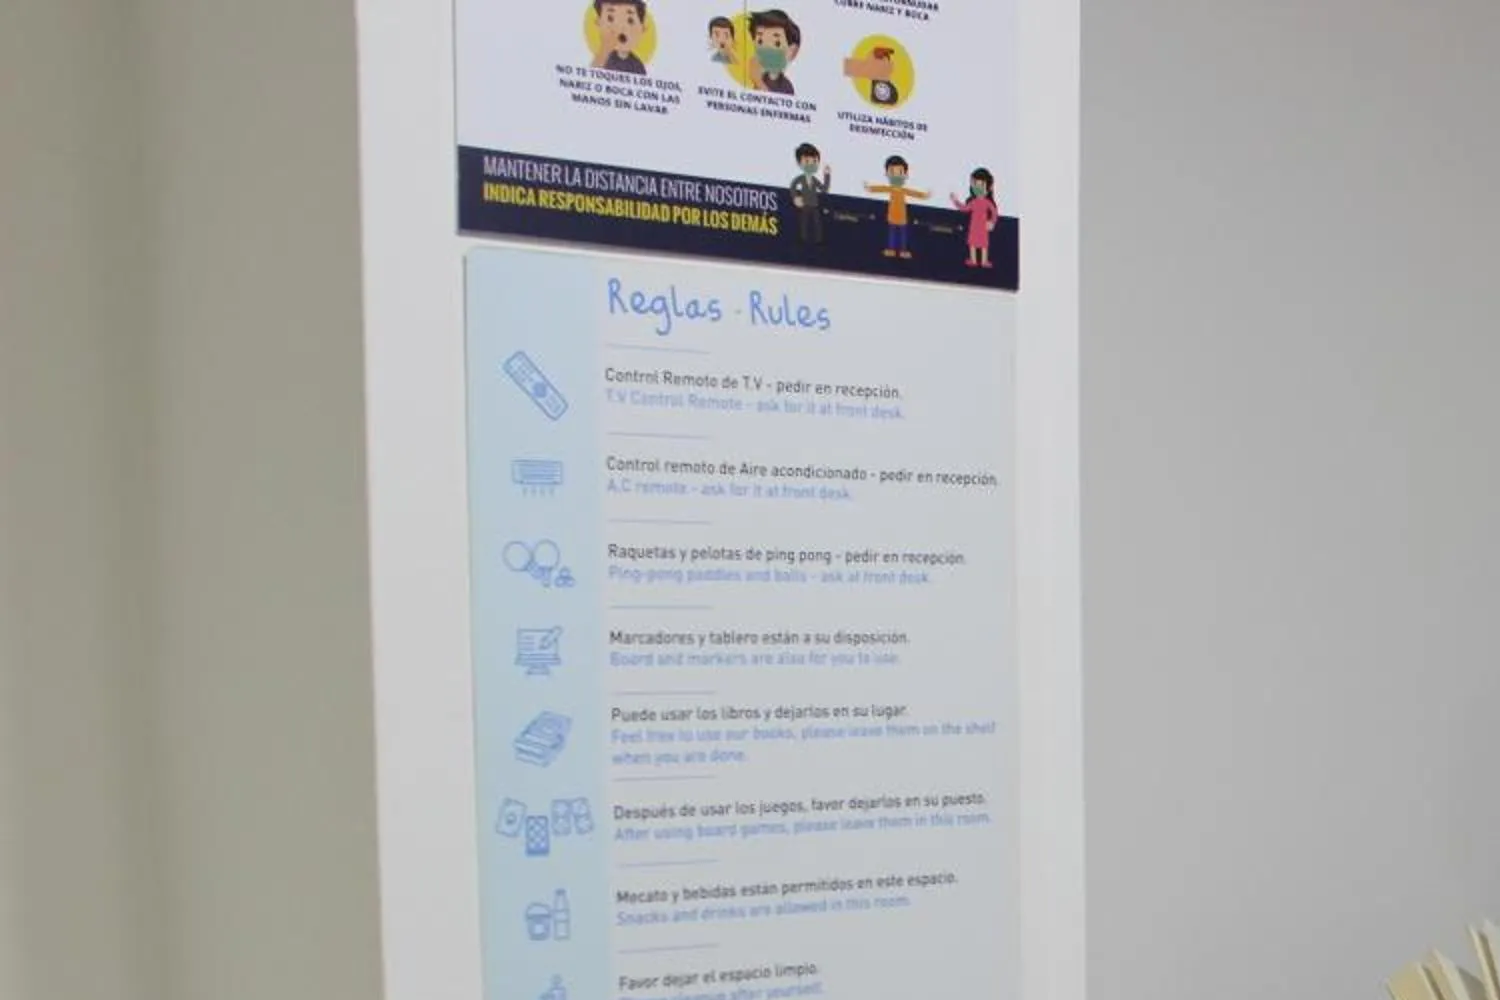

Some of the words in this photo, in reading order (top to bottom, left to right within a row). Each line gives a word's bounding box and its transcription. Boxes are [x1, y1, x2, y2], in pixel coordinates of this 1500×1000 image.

[484, 155, 561, 183] MANTENER
[564, 166, 580, 186] LA
[584, 168, 656, 195] DISTANCIA
[660, 178, 700, 201] ENTRE
[705, 184, 778, 211] NOSOTROS
[483, 182, 535, 205] INDICA
[538, 189, 670, 222] RESPONSABILIDAD
[672, 205, 700, 225] POR
[703, 209, 728, 228] LOS
[731, 211, 778, 234] DEMÁS
[607, 277, 722, 336] Reglas
[750, 290, 831, 331] Rules
[606, 455, 660, 472] Control
[664, 461, 715, 475] remoto
[719, 462, 735, 475] de
[740, 462, 767, 476] Aire
[770, 464, 866, 480] acondicionado
[879, 469, 912, 482] pedir
[917, 472, 932, 482] en
[609, 630, 694, 644] Marcadores
[698, 634, 705, 648] y
[709, 630, 758, 644] tablero
[762, 631, 798, 644] están
[803, 633, 810, 644] a
[814, 633, 830, 644] su
[611, 707, 656, 722] Puede
[660, 709, 692, 720] usar
[696, 706, 716, 720] los
[721, 707, 760, 719] libros
[763, 709, 771, 722] y
[774, 705, 829, 721] dejarlos
[832, 707, 849, 717] en
[852, 707, 868, 717] su
